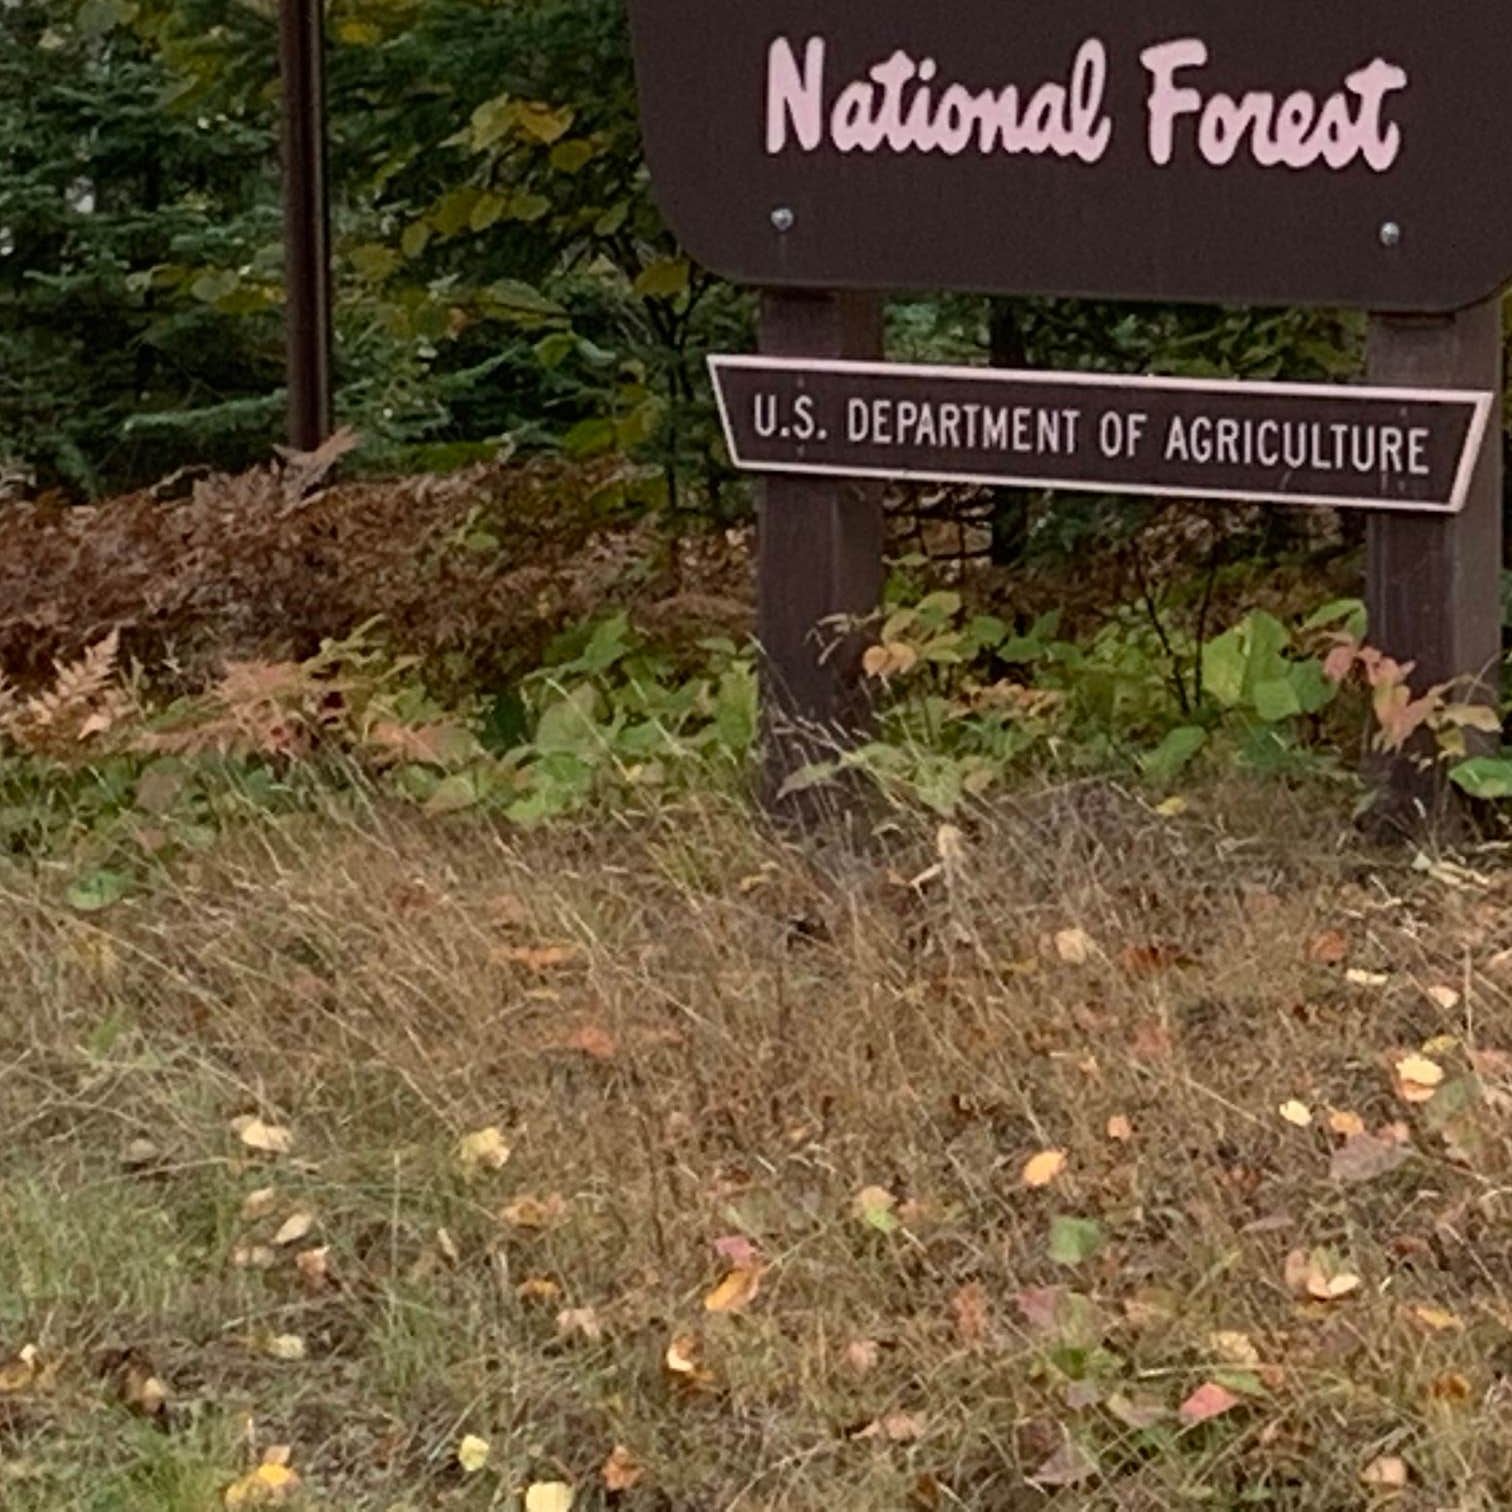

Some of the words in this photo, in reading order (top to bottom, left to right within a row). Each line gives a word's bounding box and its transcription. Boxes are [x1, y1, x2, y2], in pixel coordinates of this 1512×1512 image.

[765, 36, 1111, 164] National
[1140, 37, 1407, 172] Forest
[754, 393, 828, 439] U.S.
[848, 397, 1081, 455] DEPARTMENT
[1100, 410, 1148, 458] OF
[1164, 415, 1429, 475] AGRICULTURE
